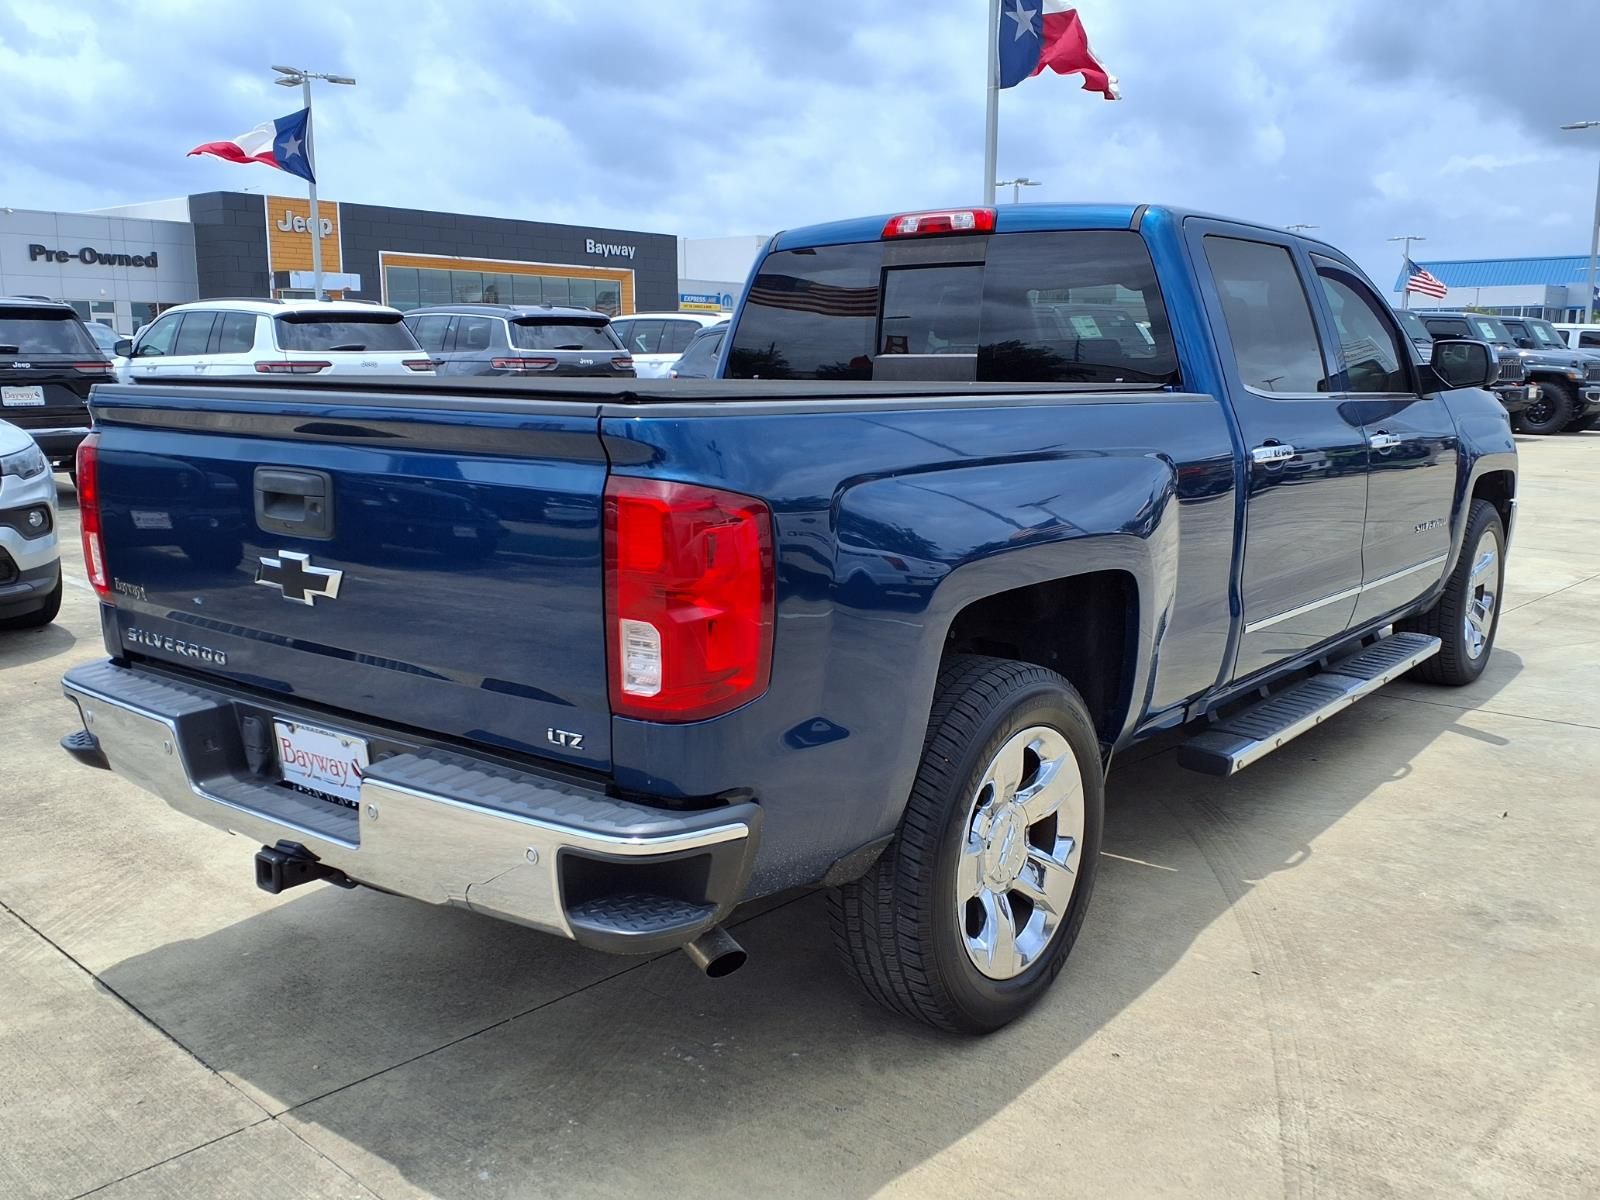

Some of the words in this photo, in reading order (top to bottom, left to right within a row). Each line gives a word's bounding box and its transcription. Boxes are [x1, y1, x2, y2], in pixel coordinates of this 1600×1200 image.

[29, 243, 159, 268] Pre-Owned
[586, 238, 636, 259] Bayway
[127, 627, 226, 665] SILVERADO
[547, 727, 583, 750] LTZ
[280, 736, 349, 787] Bayway
